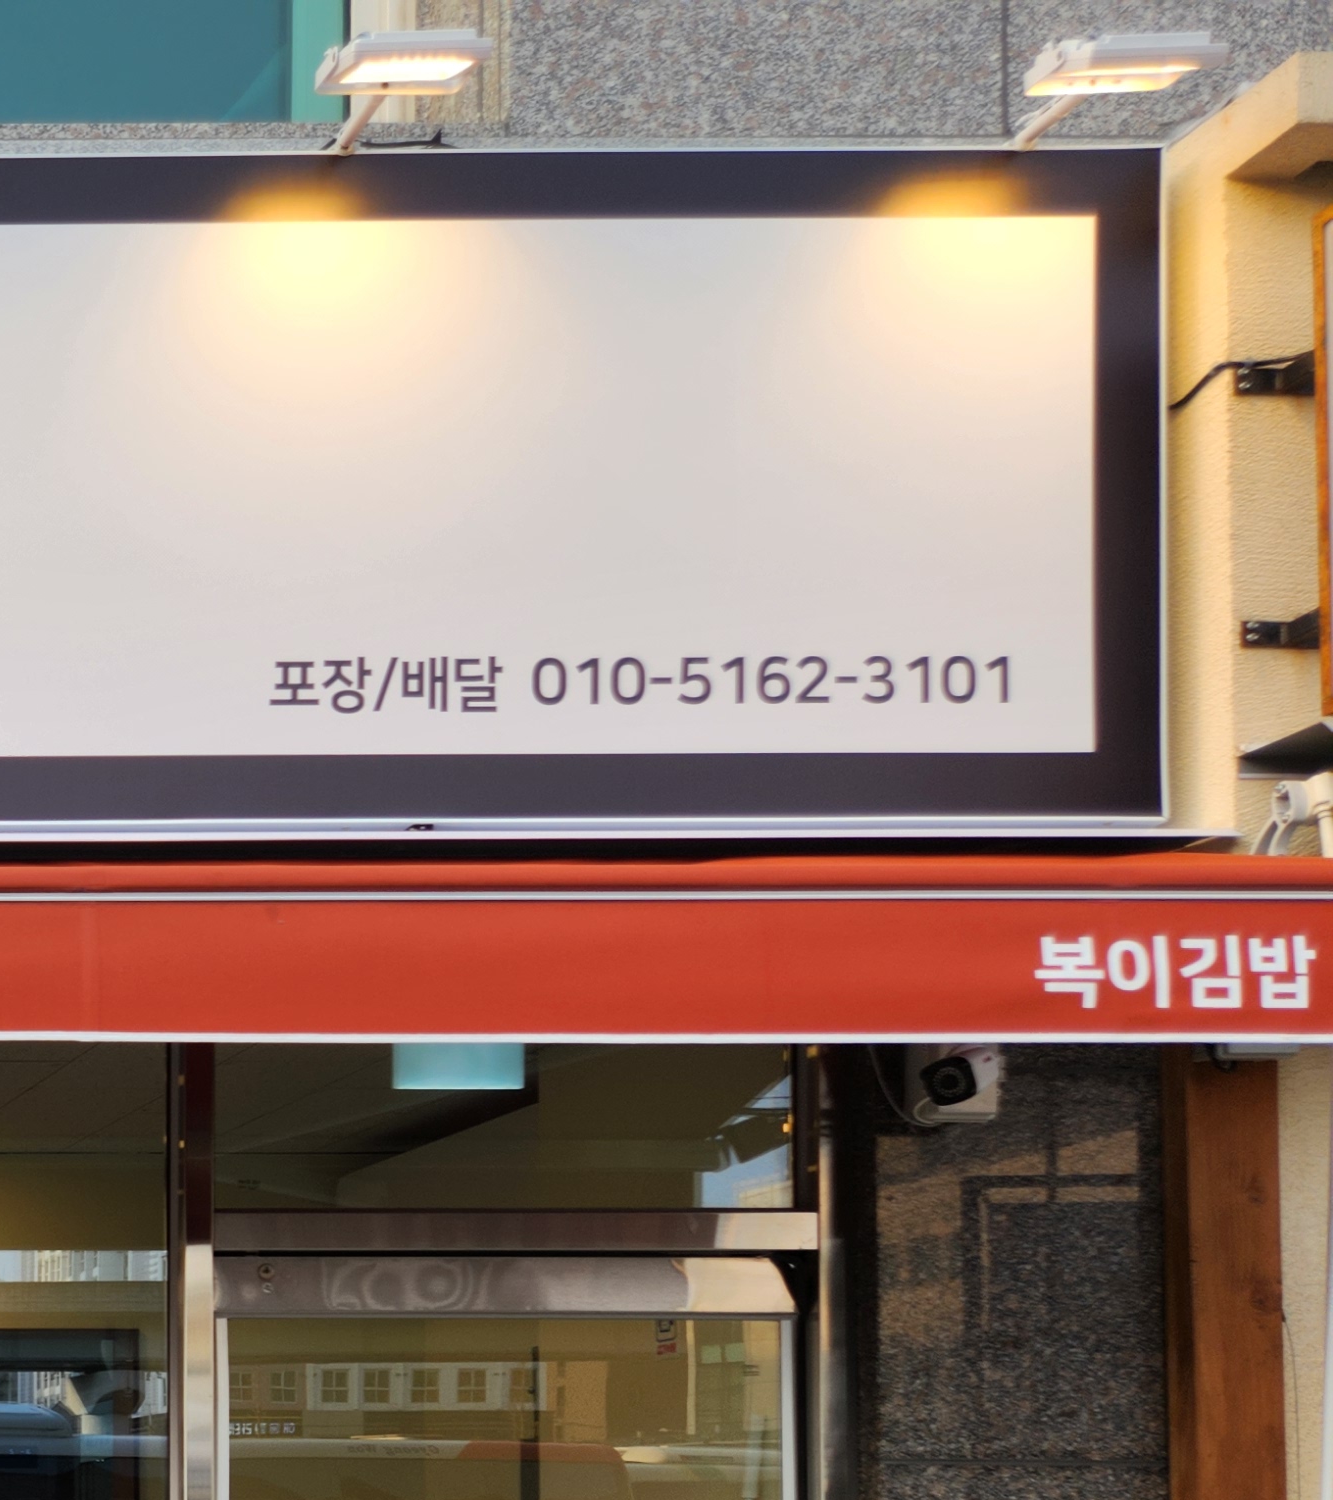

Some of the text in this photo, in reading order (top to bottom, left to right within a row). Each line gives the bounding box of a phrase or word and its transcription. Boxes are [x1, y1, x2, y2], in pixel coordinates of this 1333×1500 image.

[269, 655, 1012, 714] 포장/배달 010-5162-3101
[1034, 935, 1317, 1009] 복이김밥
